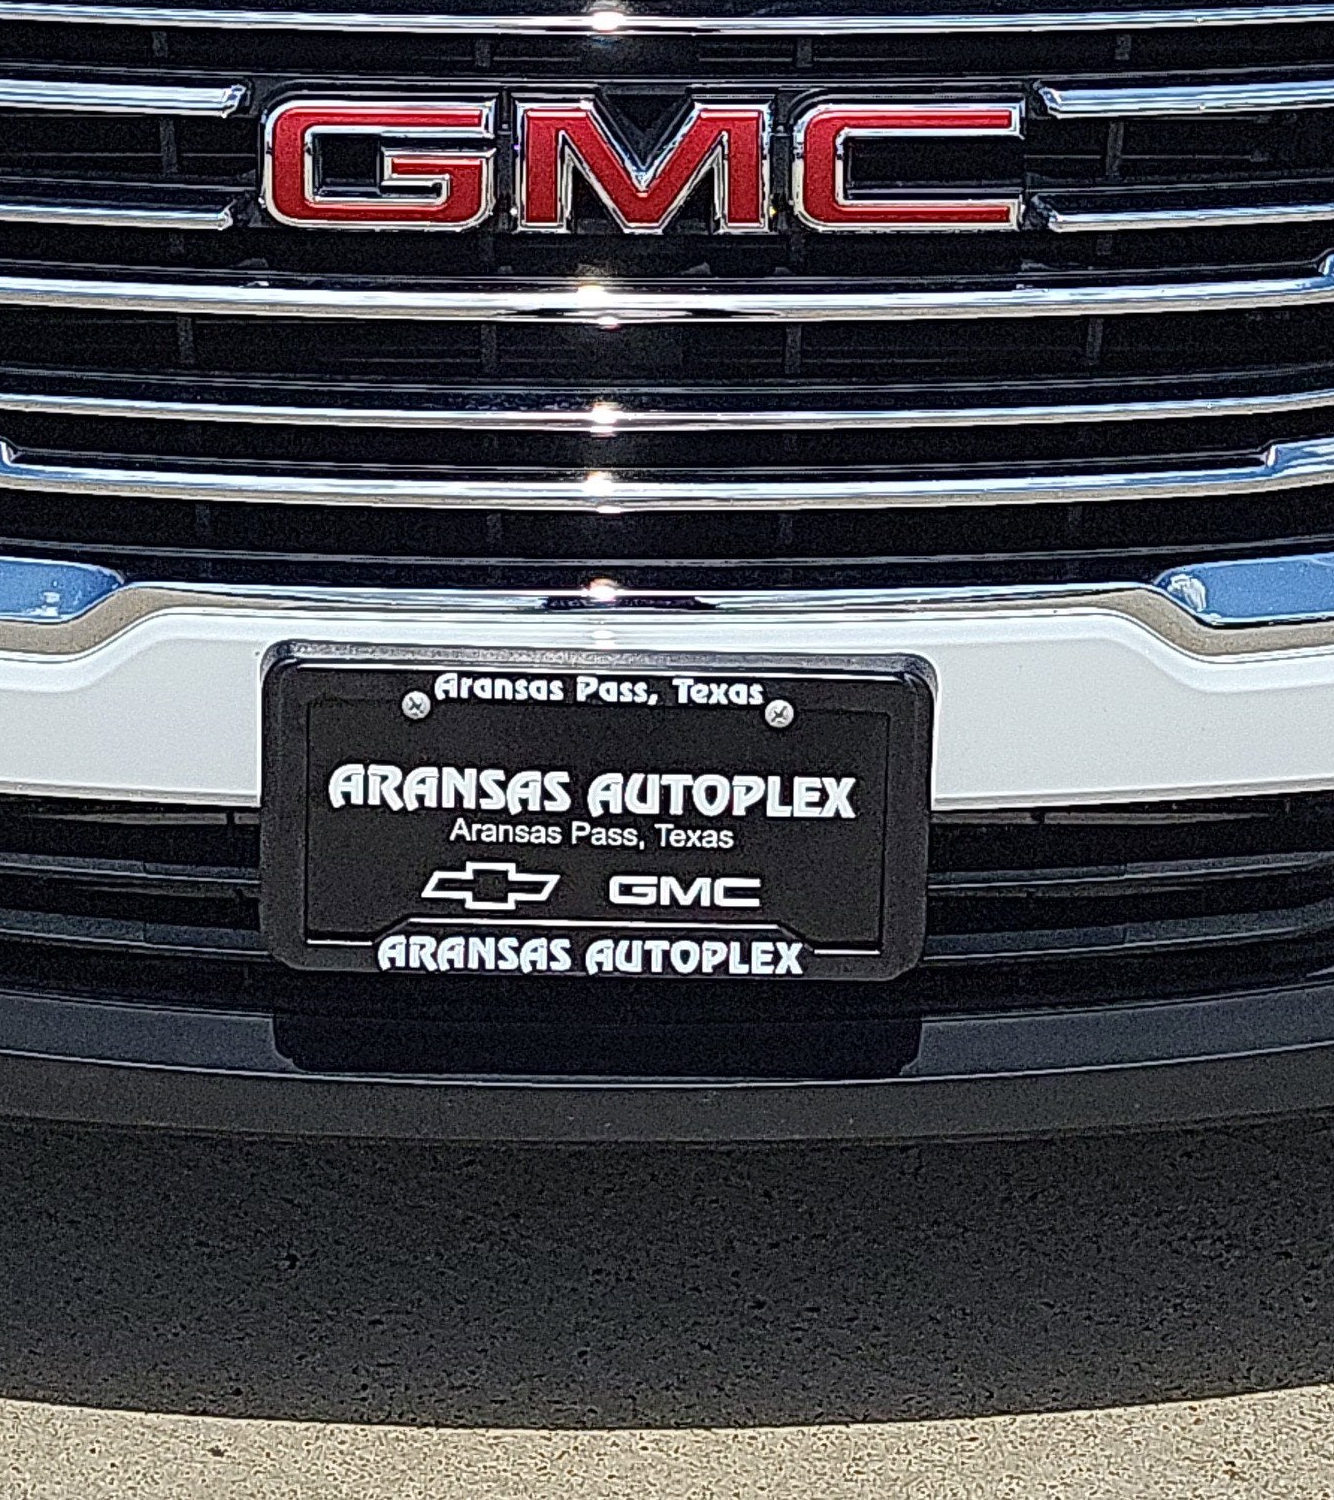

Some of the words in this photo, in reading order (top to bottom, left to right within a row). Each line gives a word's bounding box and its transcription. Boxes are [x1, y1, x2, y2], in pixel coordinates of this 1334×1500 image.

[261, 91, 1026, 234] GMC
[434, 672, 563, 702] Aransas
[576, 676, 659, 706] Pass,
[673, 677, 766, 706] Texas
[328, 763, 572, 814] ARANSAS
[588, 773, 857, 819] AUTOPLEX
[450, 817, 562, 845] Aransas
[572, 821, 645, 850] Pass,
[655, 823, 735, 850] Texas
[609, 874, 761, 908] GMC
[377, 934, 575, 973] ARANSAS
[584, 938, 804, 976] AUTOPLEX
